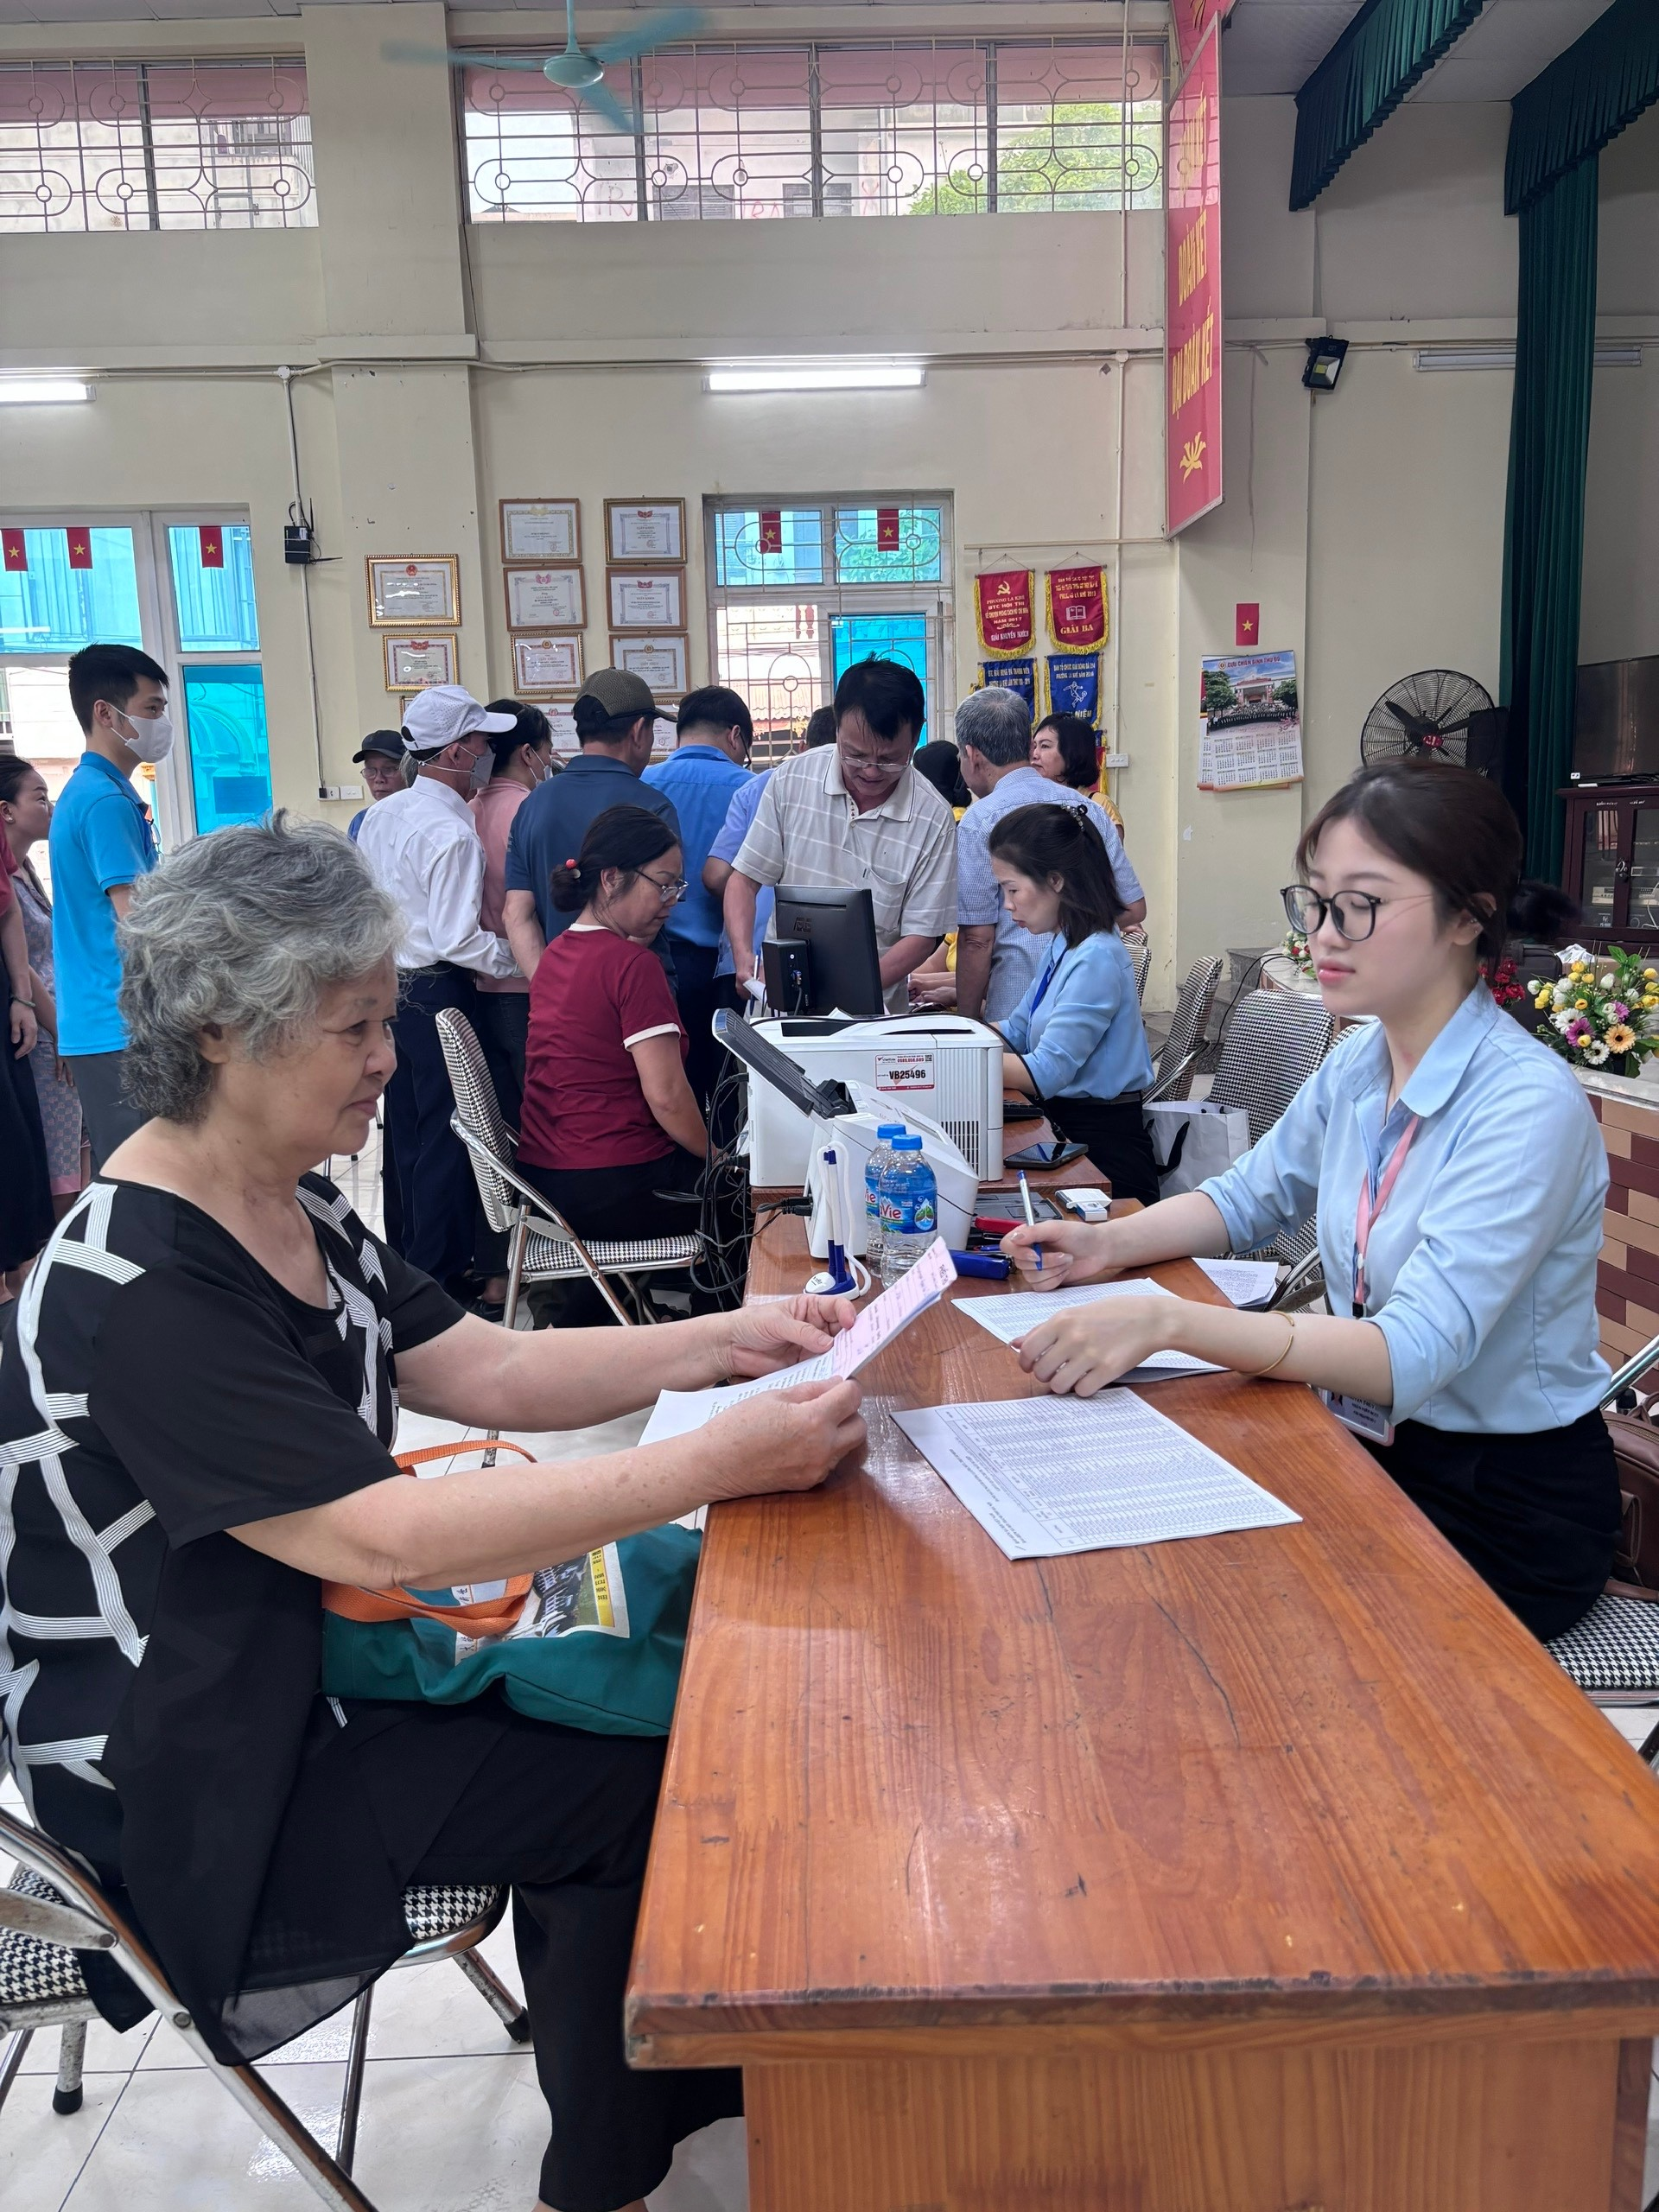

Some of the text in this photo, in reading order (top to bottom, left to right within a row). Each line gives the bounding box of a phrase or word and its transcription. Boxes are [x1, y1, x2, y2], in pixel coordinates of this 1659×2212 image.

[1082, 624, 1094, 632] BA
[888, 1069, 926, 1080] VB25496
[865, 1190, 876, 1203] ie
[880, 1202, 902, 1219] Vie
